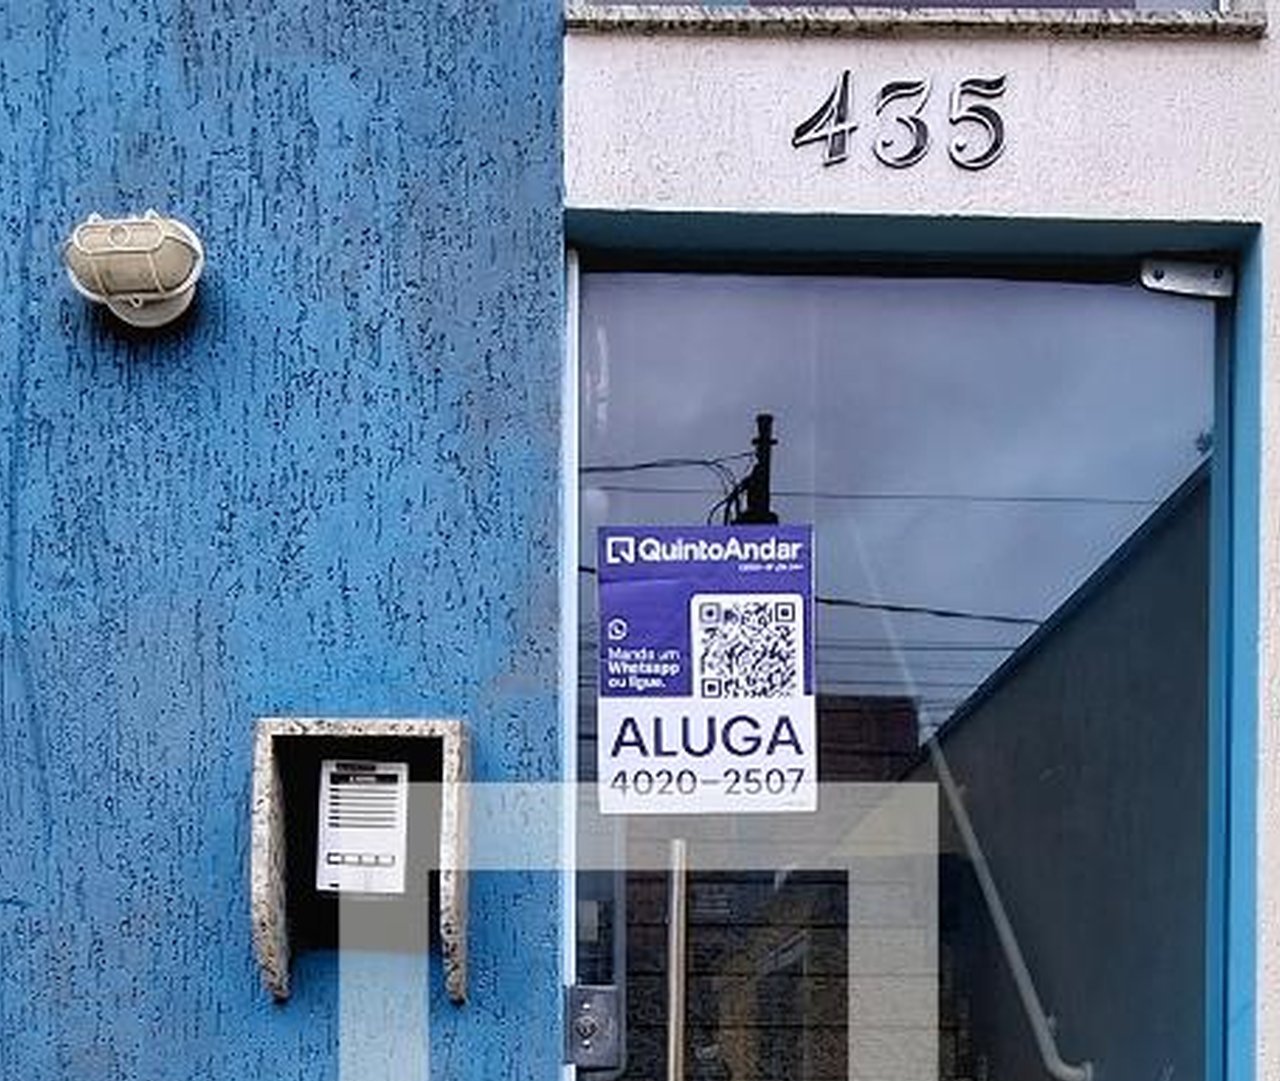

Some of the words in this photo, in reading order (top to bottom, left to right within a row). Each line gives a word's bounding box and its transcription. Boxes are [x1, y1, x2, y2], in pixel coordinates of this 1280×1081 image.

[791, 69, 1007, 171] 435
[638, 537, 803, 562] QuintoAndar
[608, 677, 627, 688] ou
[610, 715, 805, 758] ALUGA
[609, 768, 806, 797] 4020-2507
